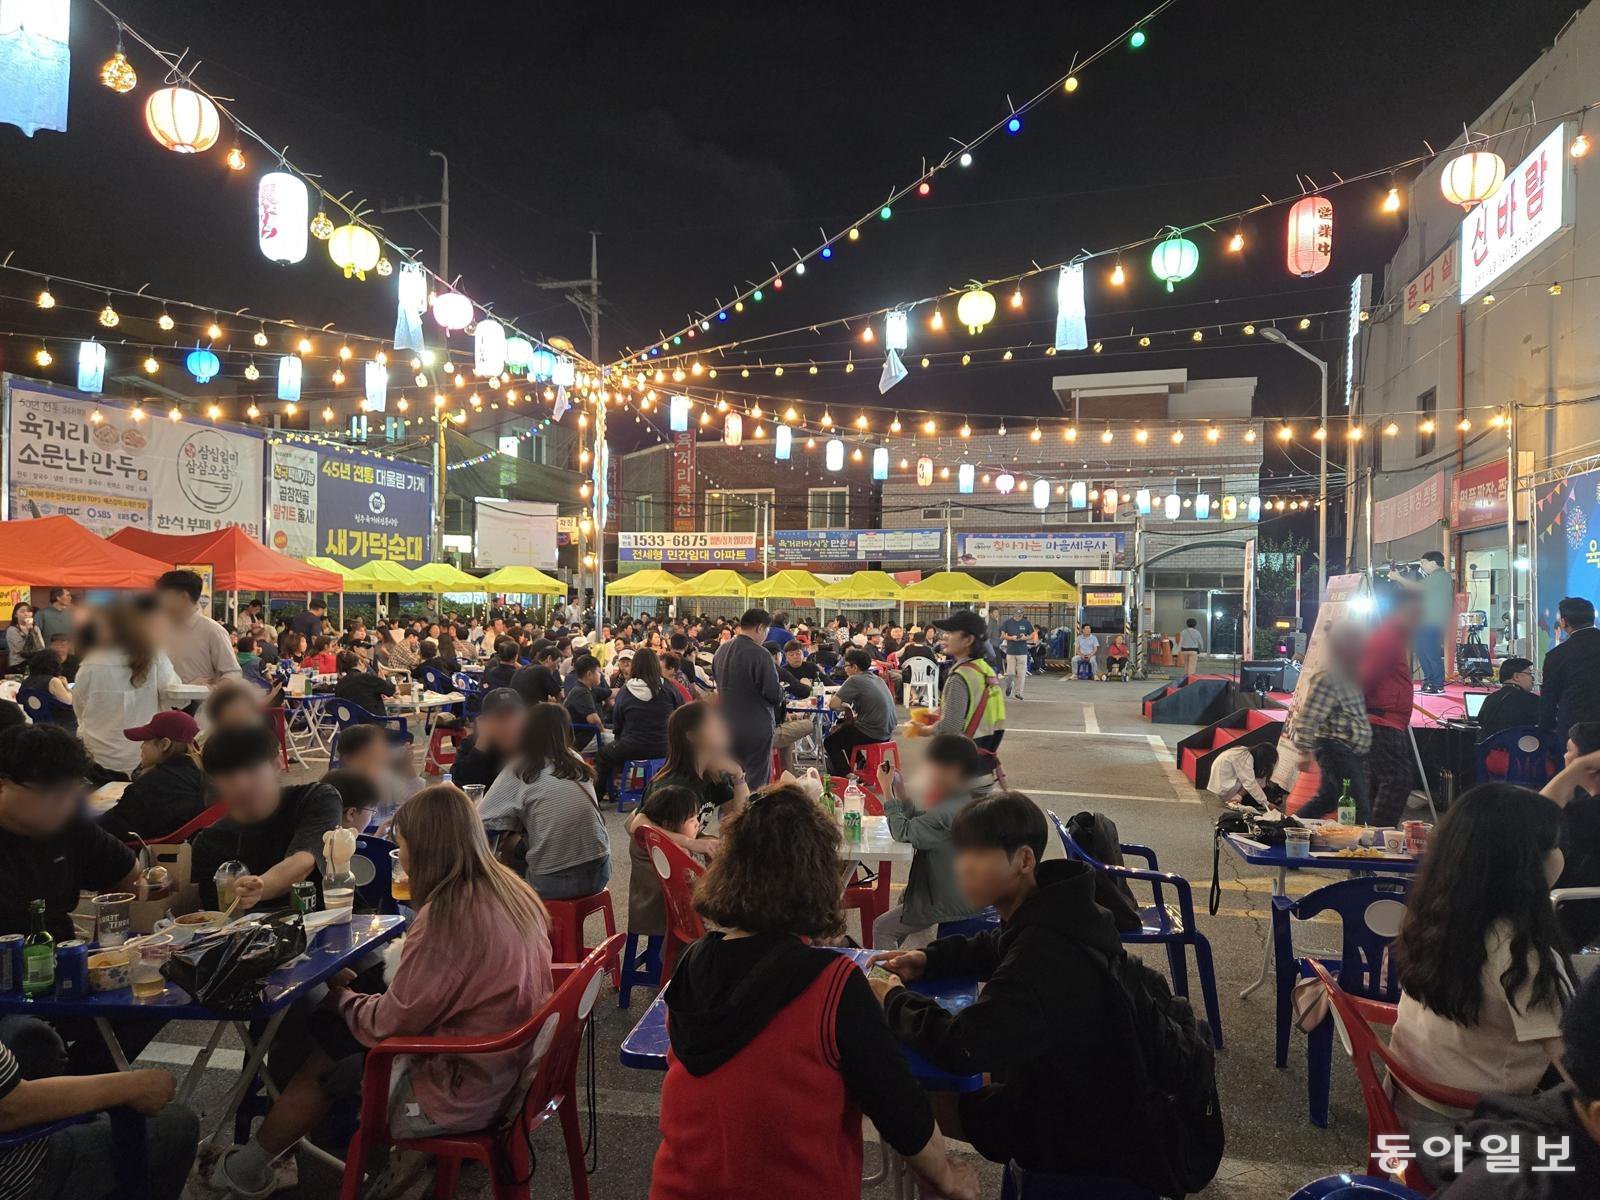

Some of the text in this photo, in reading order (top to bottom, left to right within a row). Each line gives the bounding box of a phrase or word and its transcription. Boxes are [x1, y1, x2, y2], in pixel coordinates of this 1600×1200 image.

[1472, 150, 1549, 267] 신바람
[19, 412, 89, 443] 육거리
[198, 445, 238, 466] 삼십일미
[322, 460, 426, 493] 45년 전통 대물림 가게
[677, 432, 692, 517] 육거리축산
[280, 486, 310, 505] 곱창전골
[273, 504, 297, 520] 밀키트
[157, 514, 184, 530] 한식
[188, 517, 211, 532] 부페
[325, 528, 423, 561] 새가덕순대
[633, 534, 708, 547] 1533-6875
[993, 540, 1042, 552] 찾아가는
[1046, 540, 1108, 552] 마을세무사
[632, 549, 747, 560] 전세형 민간임대 아파트
